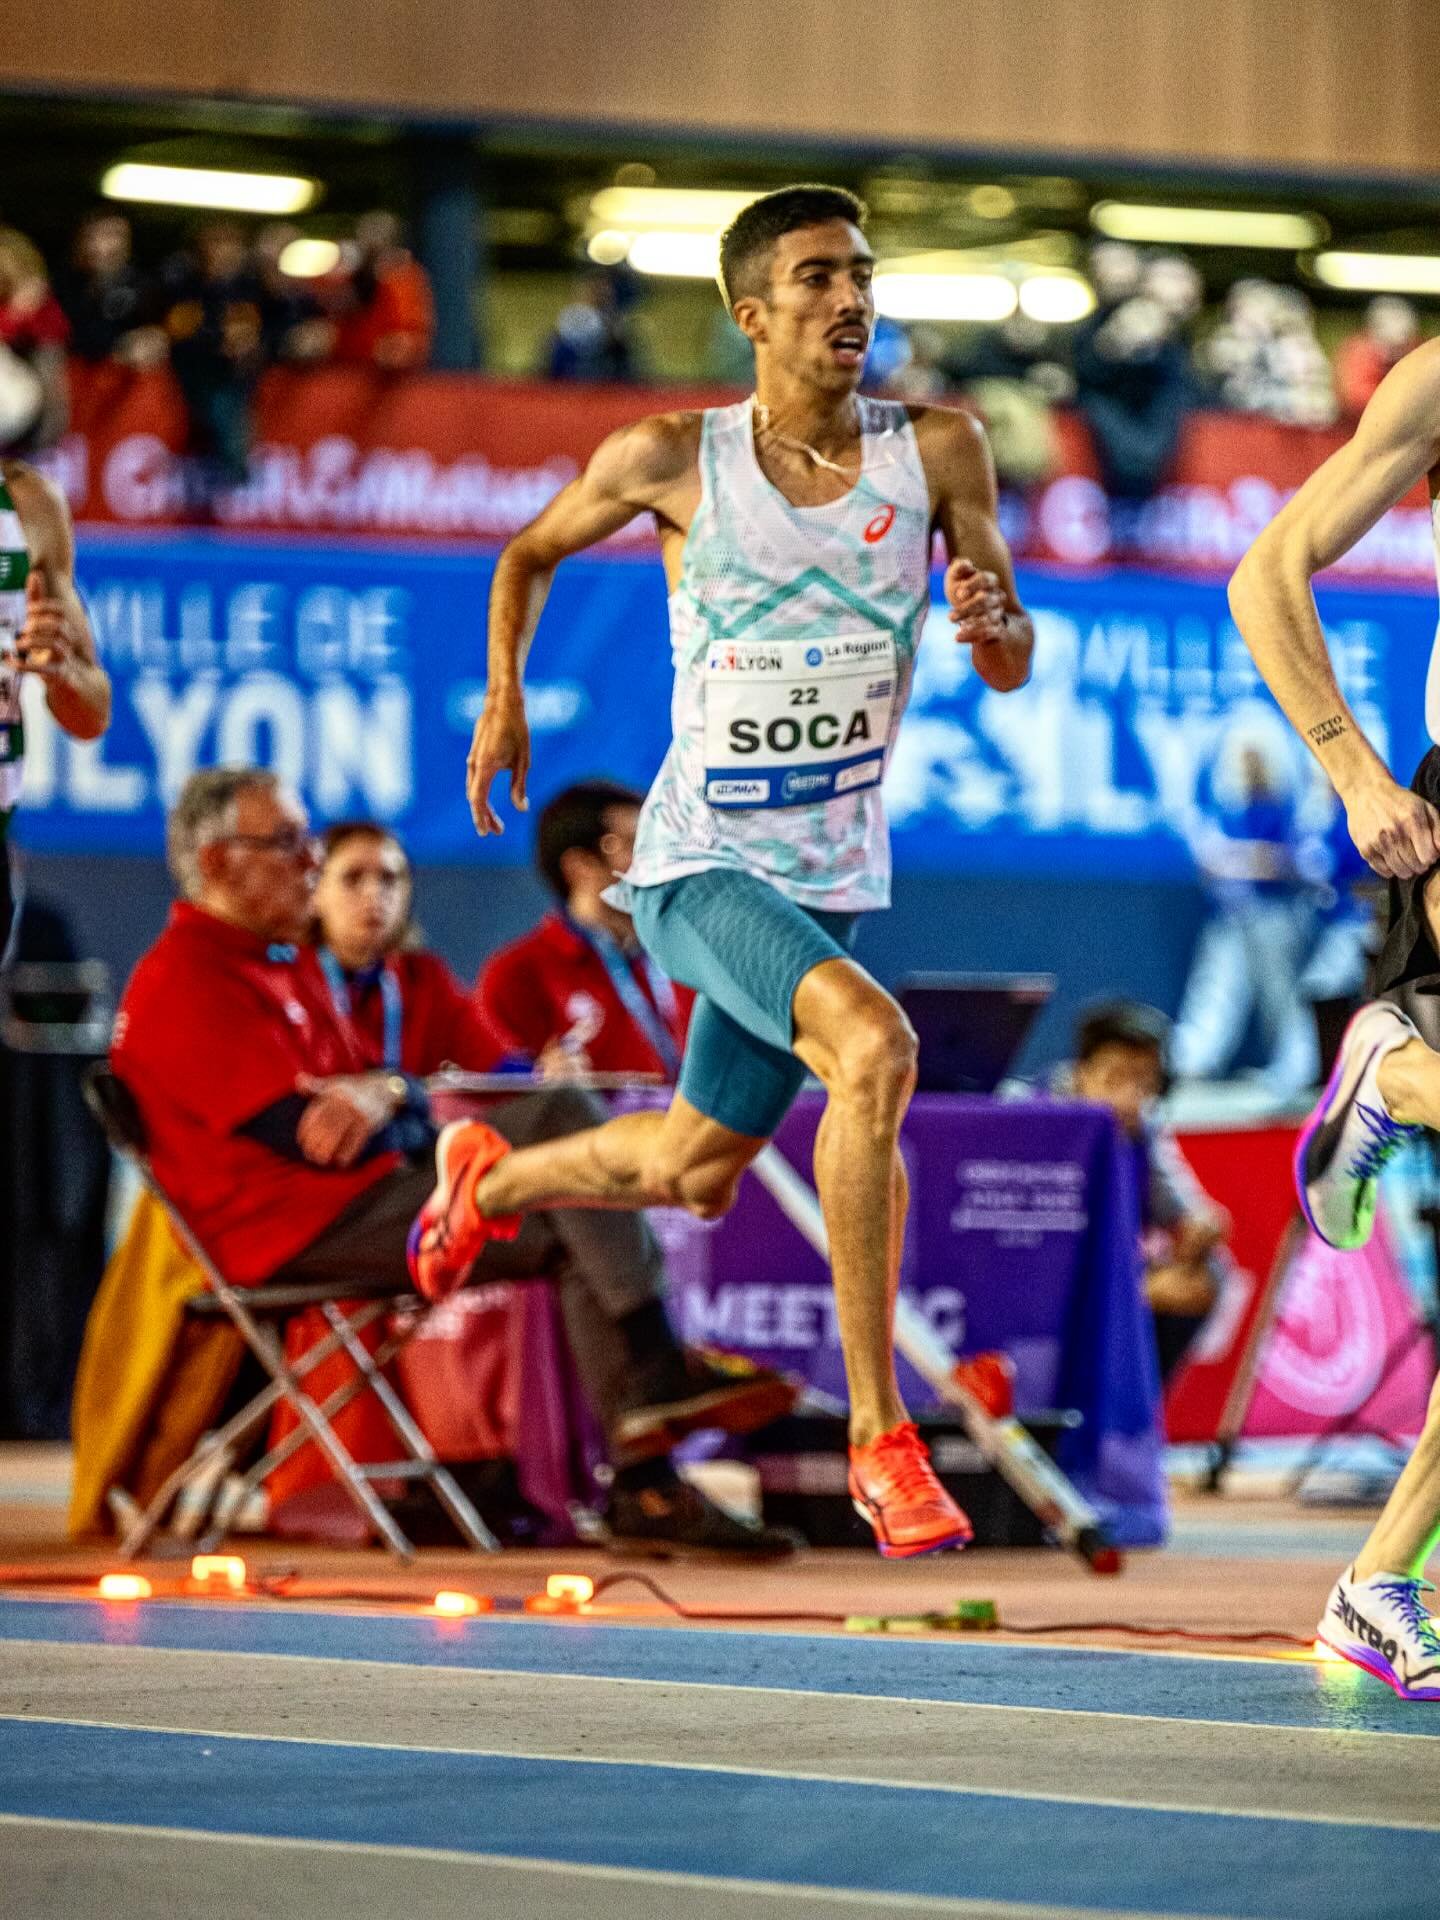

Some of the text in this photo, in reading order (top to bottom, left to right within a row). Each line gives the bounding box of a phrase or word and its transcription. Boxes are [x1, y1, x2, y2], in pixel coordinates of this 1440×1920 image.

[736, 656, 782, 671] LYON
[791, 687, 819, 704] 22
[729, 709, 871, 754] SOCA
[1307, 715, 1342, 738] TUTTO
[66, 670, 414, 822] LYON
